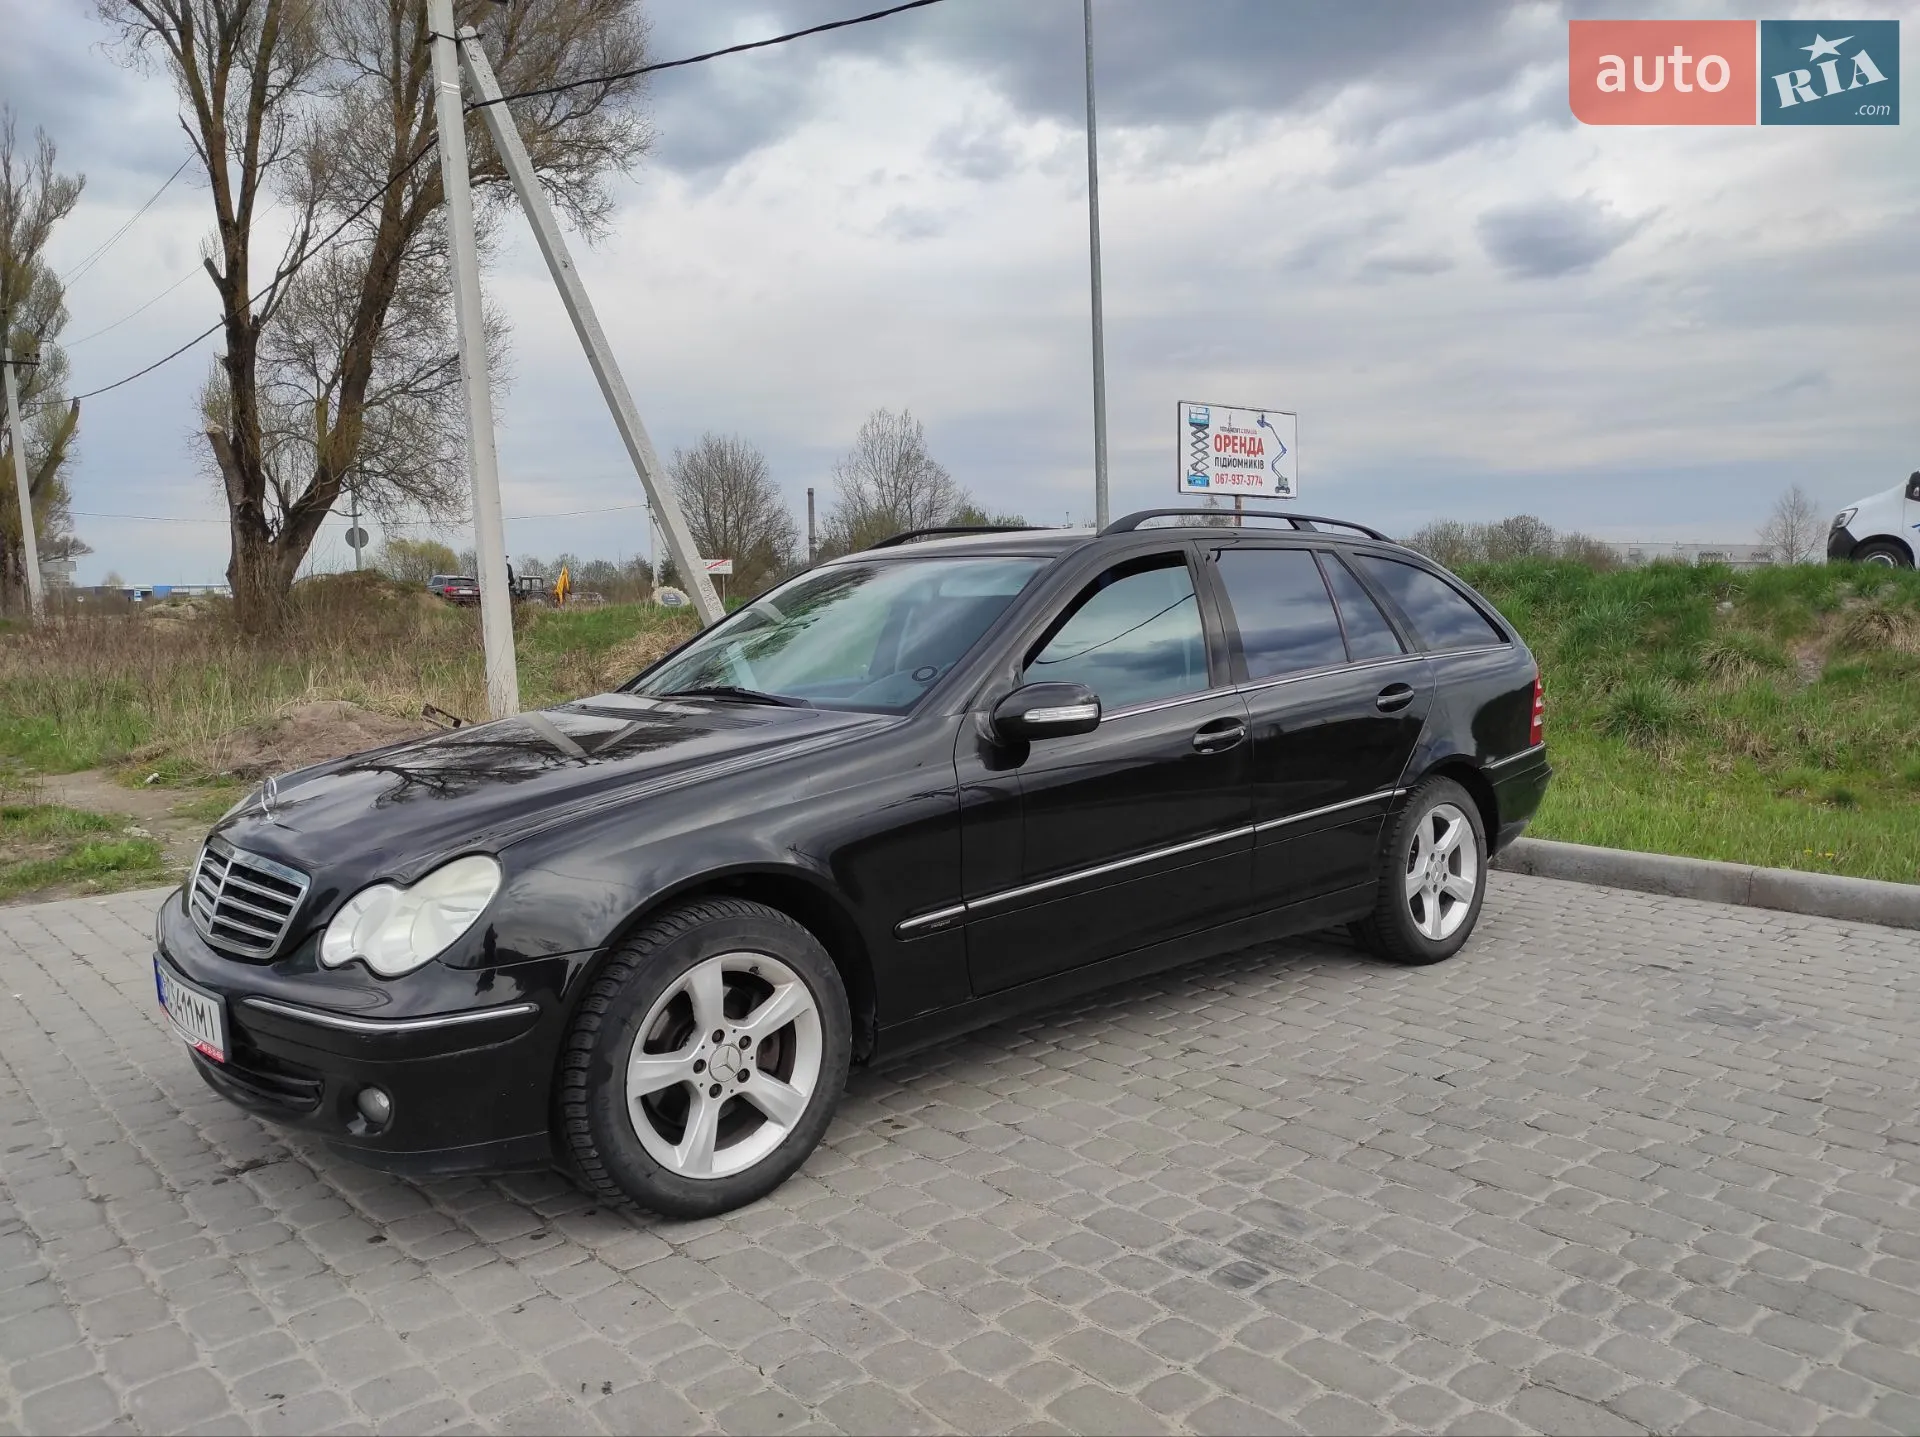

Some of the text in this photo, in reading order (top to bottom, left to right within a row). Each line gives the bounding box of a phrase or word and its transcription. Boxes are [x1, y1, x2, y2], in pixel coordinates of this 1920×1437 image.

[1214, 434, 1264, 457] ОРЕНДА
[1215, 455, 1264, 470] ПІДЙОМНИКІВ
[1215, 473, 1263, 487] 067-937-3774
